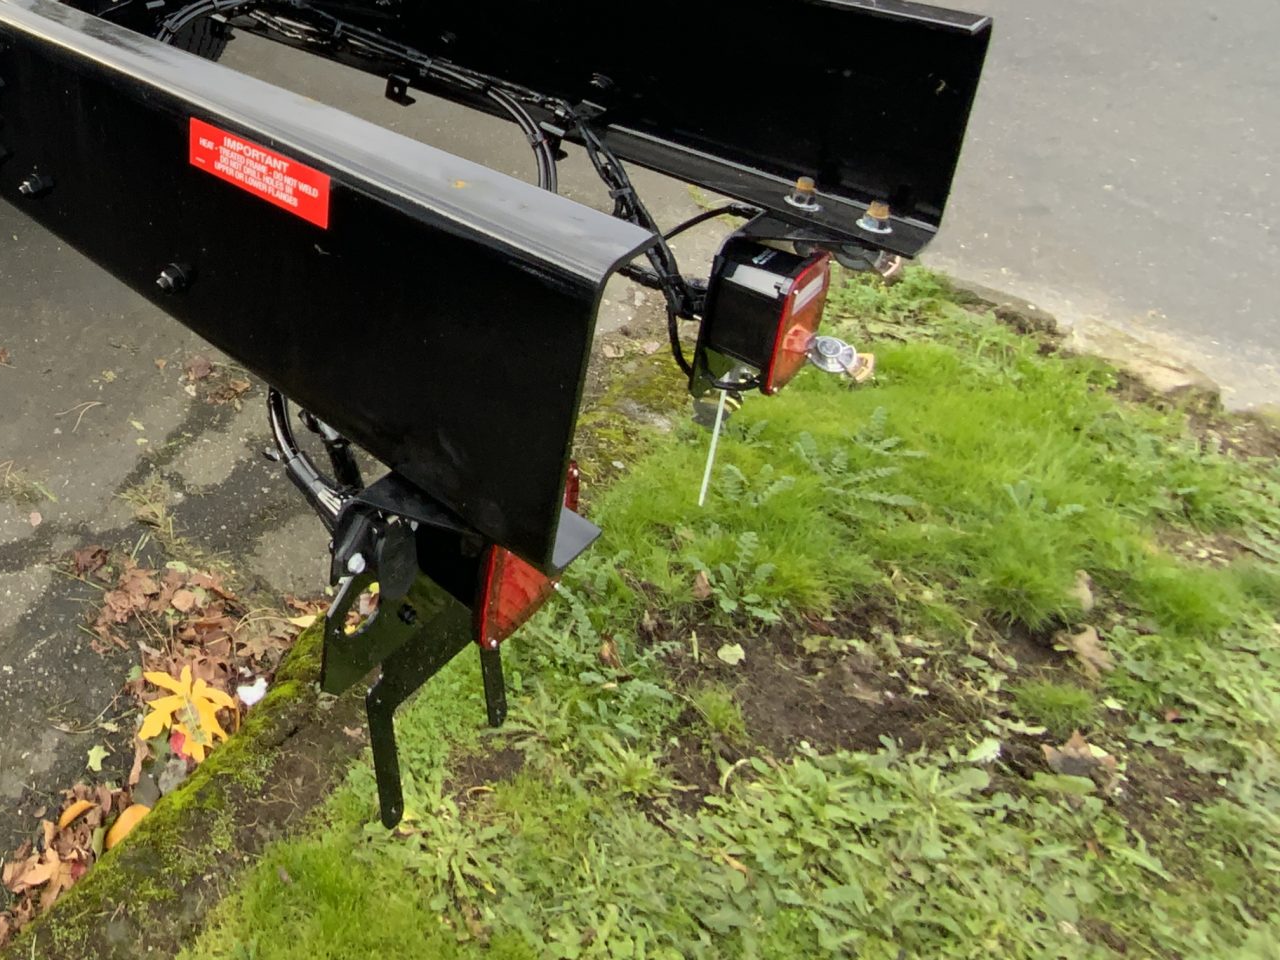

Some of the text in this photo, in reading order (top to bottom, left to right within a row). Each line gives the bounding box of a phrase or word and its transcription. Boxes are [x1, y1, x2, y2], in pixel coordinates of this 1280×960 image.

[199, 137, 215, 150] HEAT
[219, 145, 246, 164] TREATED
[246, 158, 268, 174] FRAME
[273, 170, 283, 181] DO
[284, 174, 297, 188] NOT
[298, 181, 319, 198] WELD
[220, 155, 229, 165] DO
[229, 158, 242, 171] NOT
[243, 165, 260, 180] DRILL
[262, 175, 284, 191] HOLES
[285, 184, 293, 195] IN
[223, 136, 289, 173] IMPORTANT
[214, 160, 234, 177] UPPER
[235, 170, 244, 182] OR
[244, 175, 268, 193] LOWER
[268, 186, 298, 208] FLANGES
